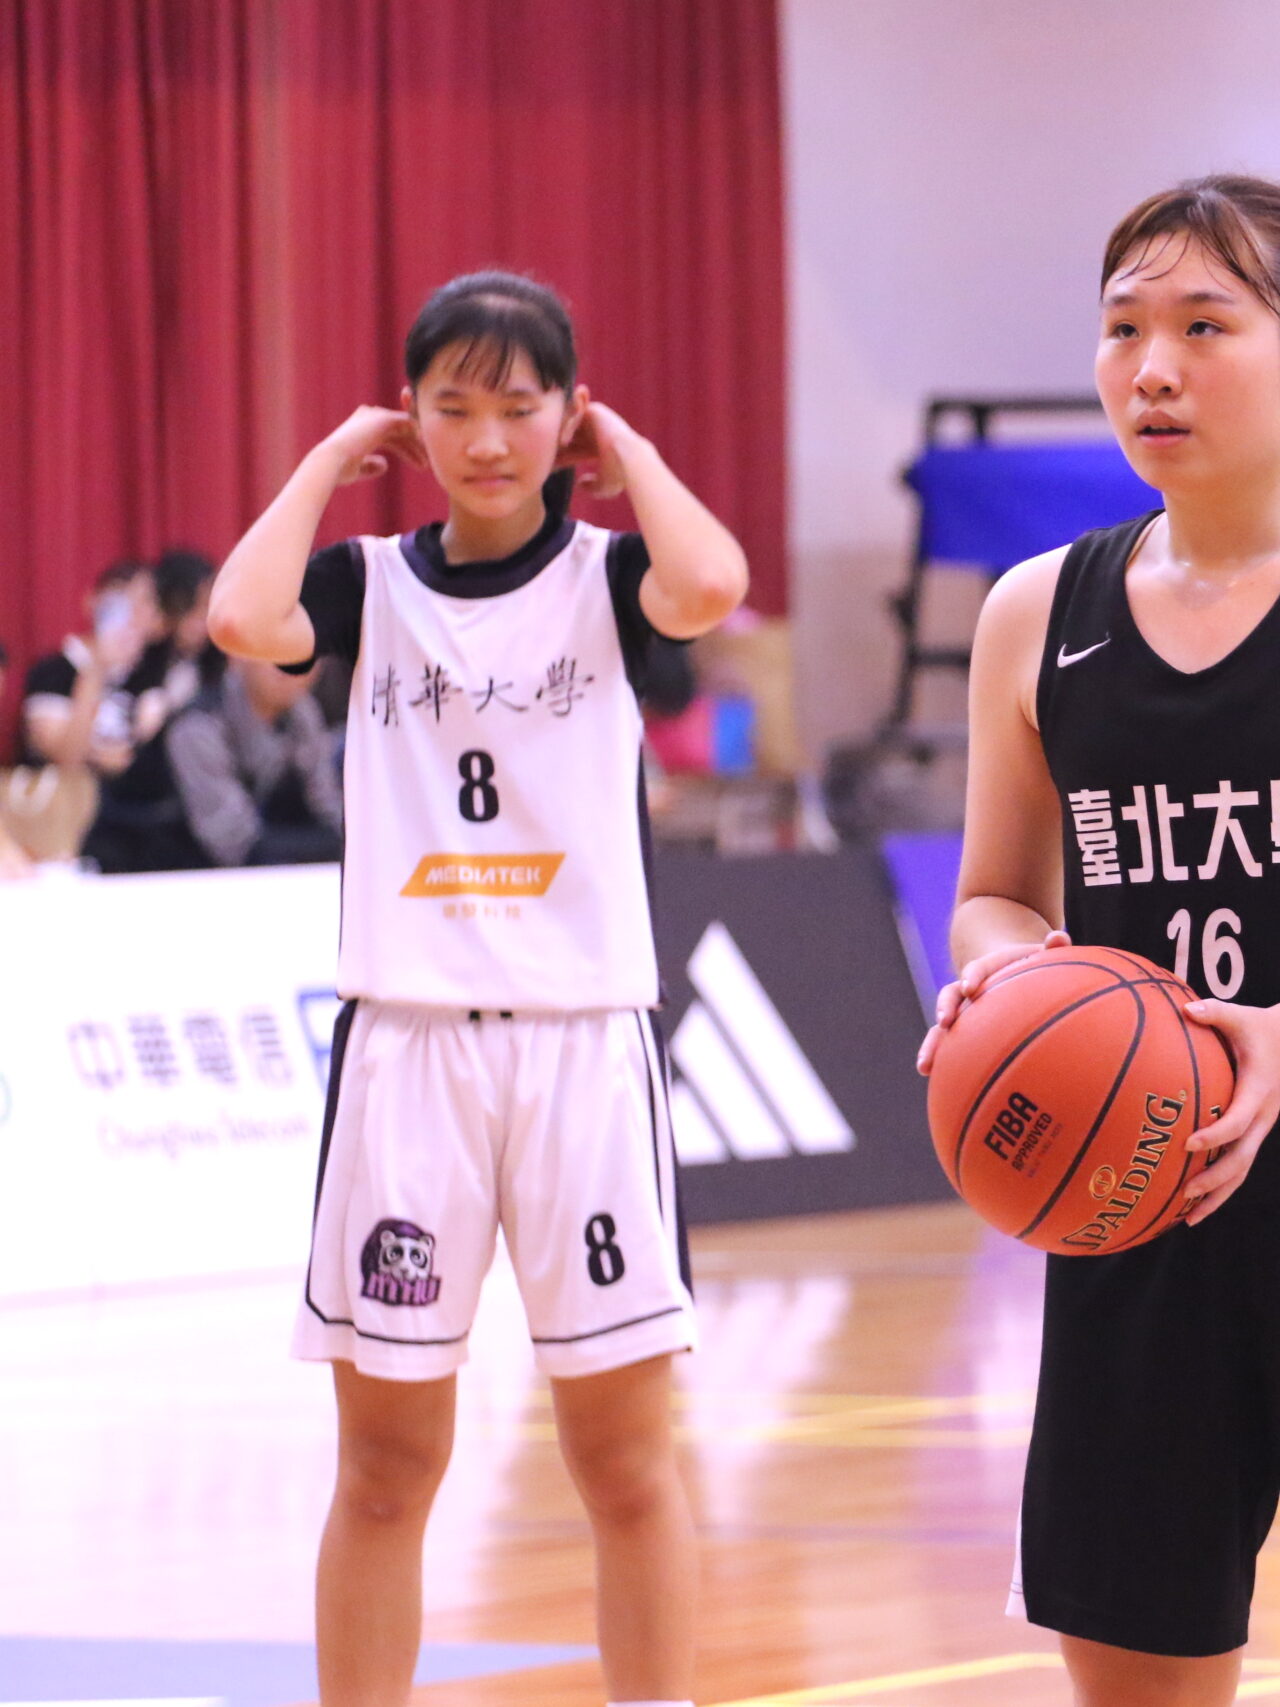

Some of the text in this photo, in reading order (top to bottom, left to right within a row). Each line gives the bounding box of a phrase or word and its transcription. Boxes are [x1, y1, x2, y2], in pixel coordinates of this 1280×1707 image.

[458, 749, 500, 824] 8
[425, 865, 542, 886] MEDIATEK
[1166, 907, 1245, 1000] 16
[984, 1091, 1038, 1161] FIBA
[1011, 1112, 1053, 1171] APPROVED
[1060, 1093, 1187, 1251] SPALDING
[585, 1212, 625, 1287] 8
